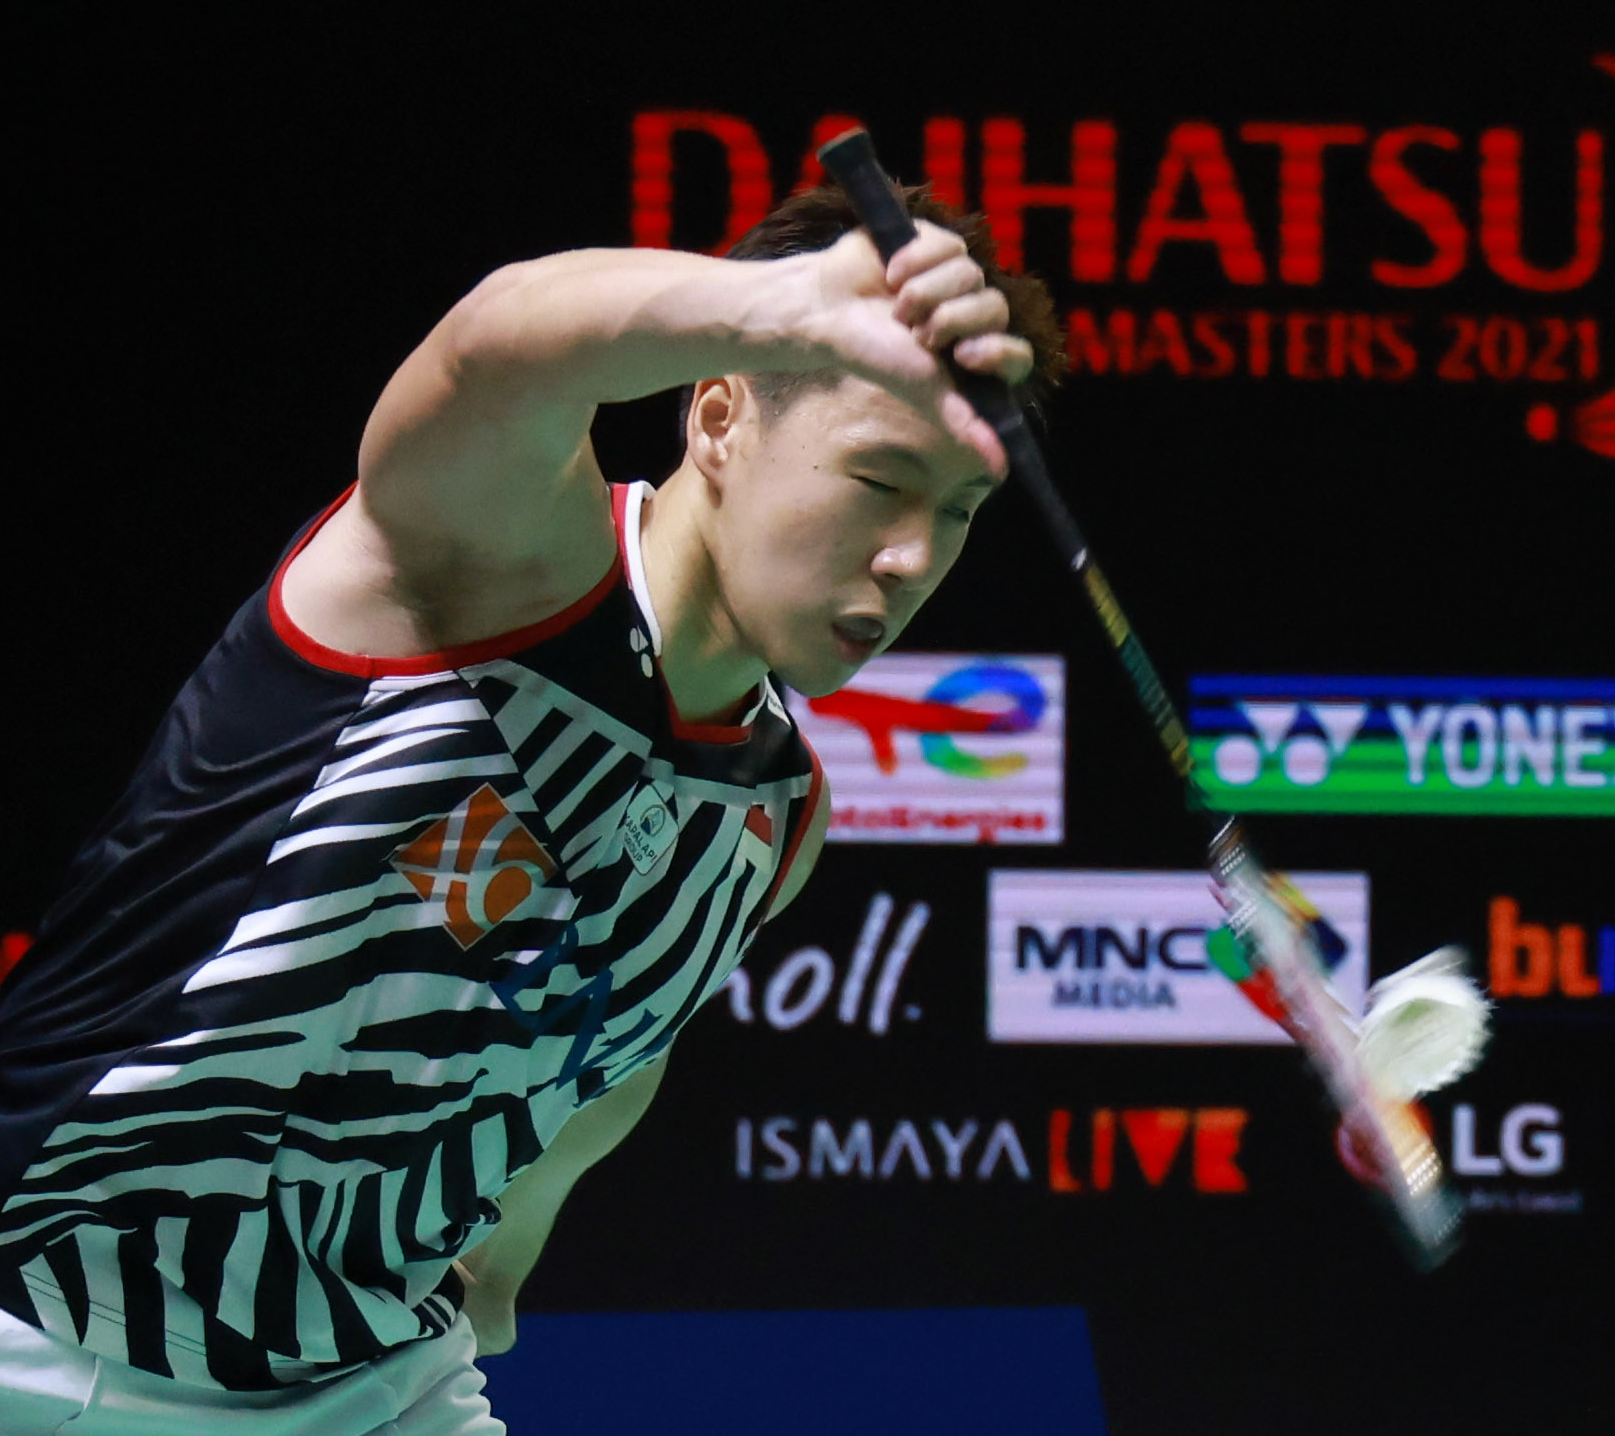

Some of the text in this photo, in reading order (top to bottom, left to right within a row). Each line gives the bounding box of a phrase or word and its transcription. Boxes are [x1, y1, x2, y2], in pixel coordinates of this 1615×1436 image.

[1067, 310, 1602, 383] MASTERS 2021
[1015, 925, 1209, 972] MNC
[1052, 976, 1178, 1012] MEDIA
[735, 1107, 1249, 1193] ISMAYA LIVE
[1451, 1104, 1565, 1179] LG
